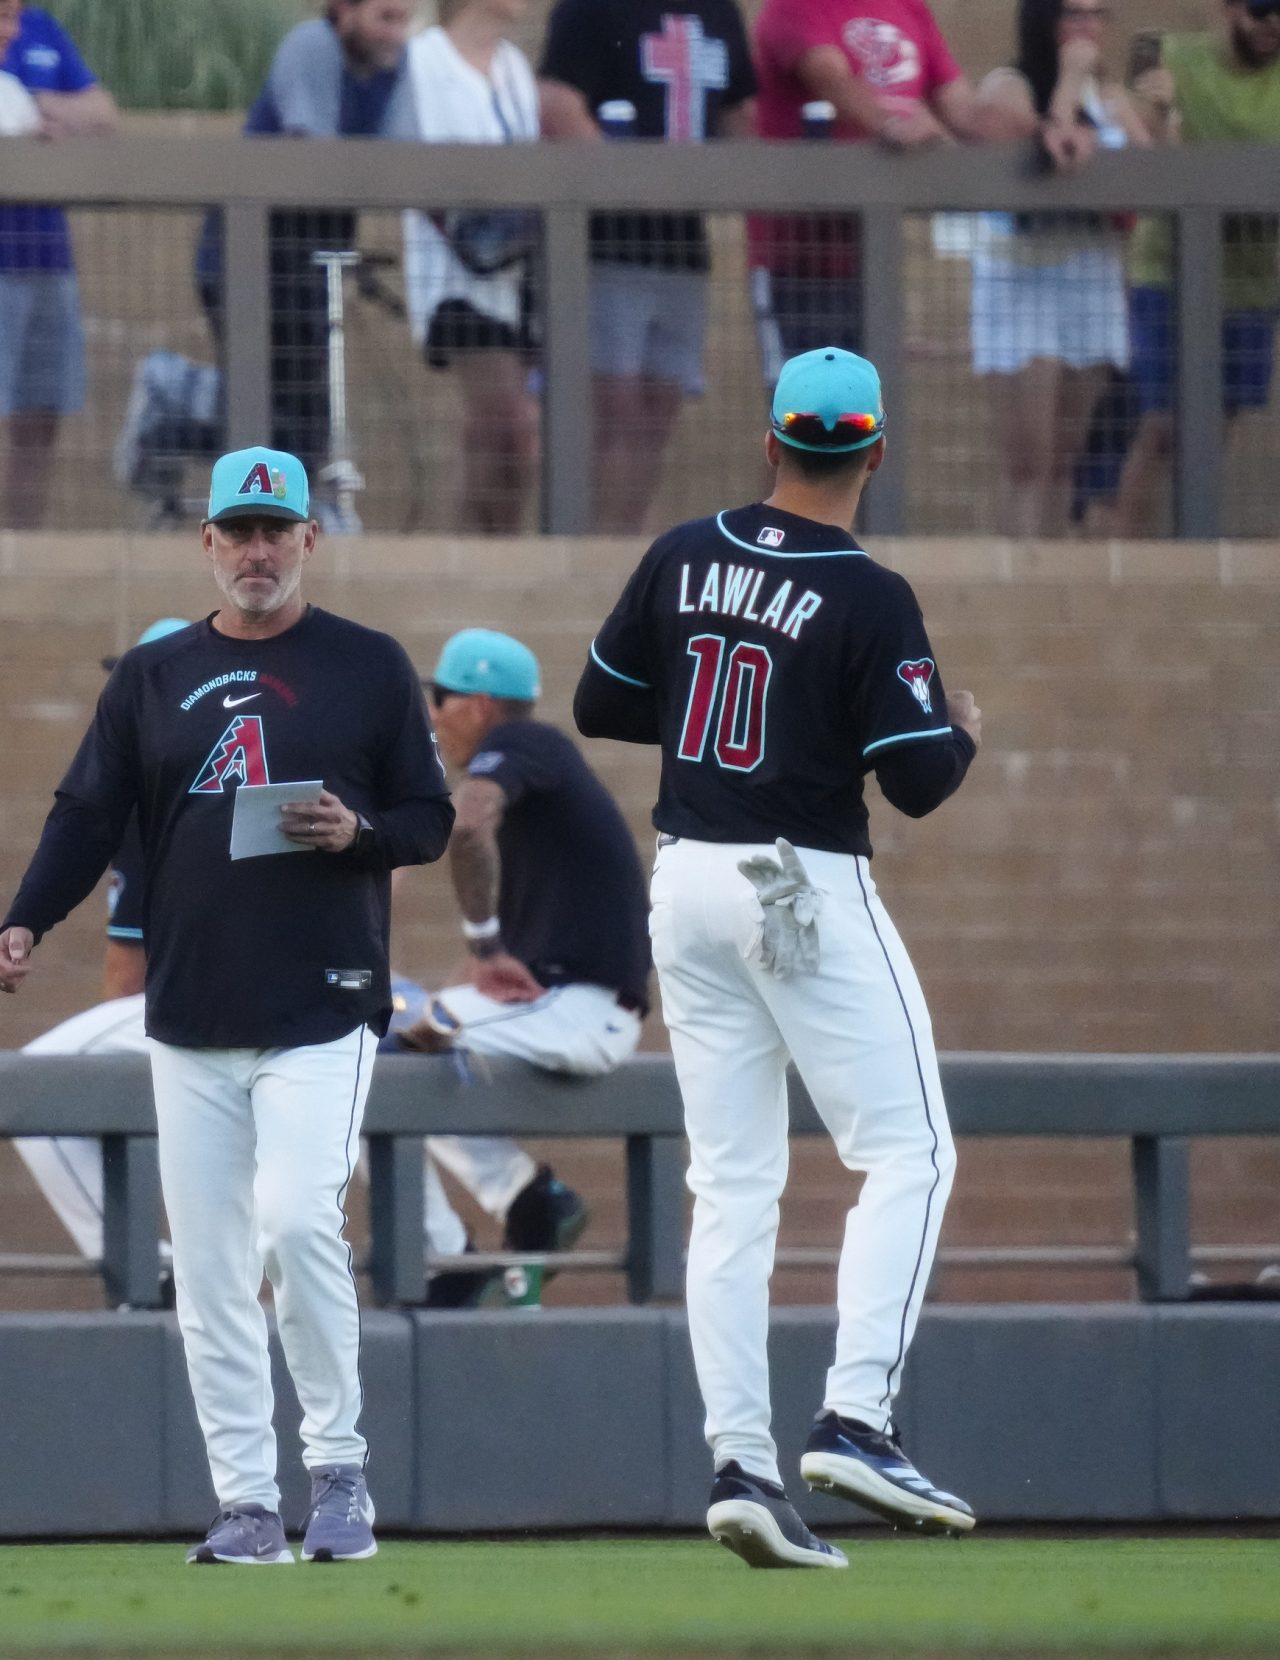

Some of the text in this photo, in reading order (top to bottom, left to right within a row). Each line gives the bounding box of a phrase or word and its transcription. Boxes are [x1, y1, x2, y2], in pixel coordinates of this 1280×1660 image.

[236, 461, 274, 496] A
[679, 562, 822, 639] LAWLAR
[180, 670, 257, 711] DIAMONDBACKS
[677, 633, 773, 773] 10
[187, 715, 270, 793] A
